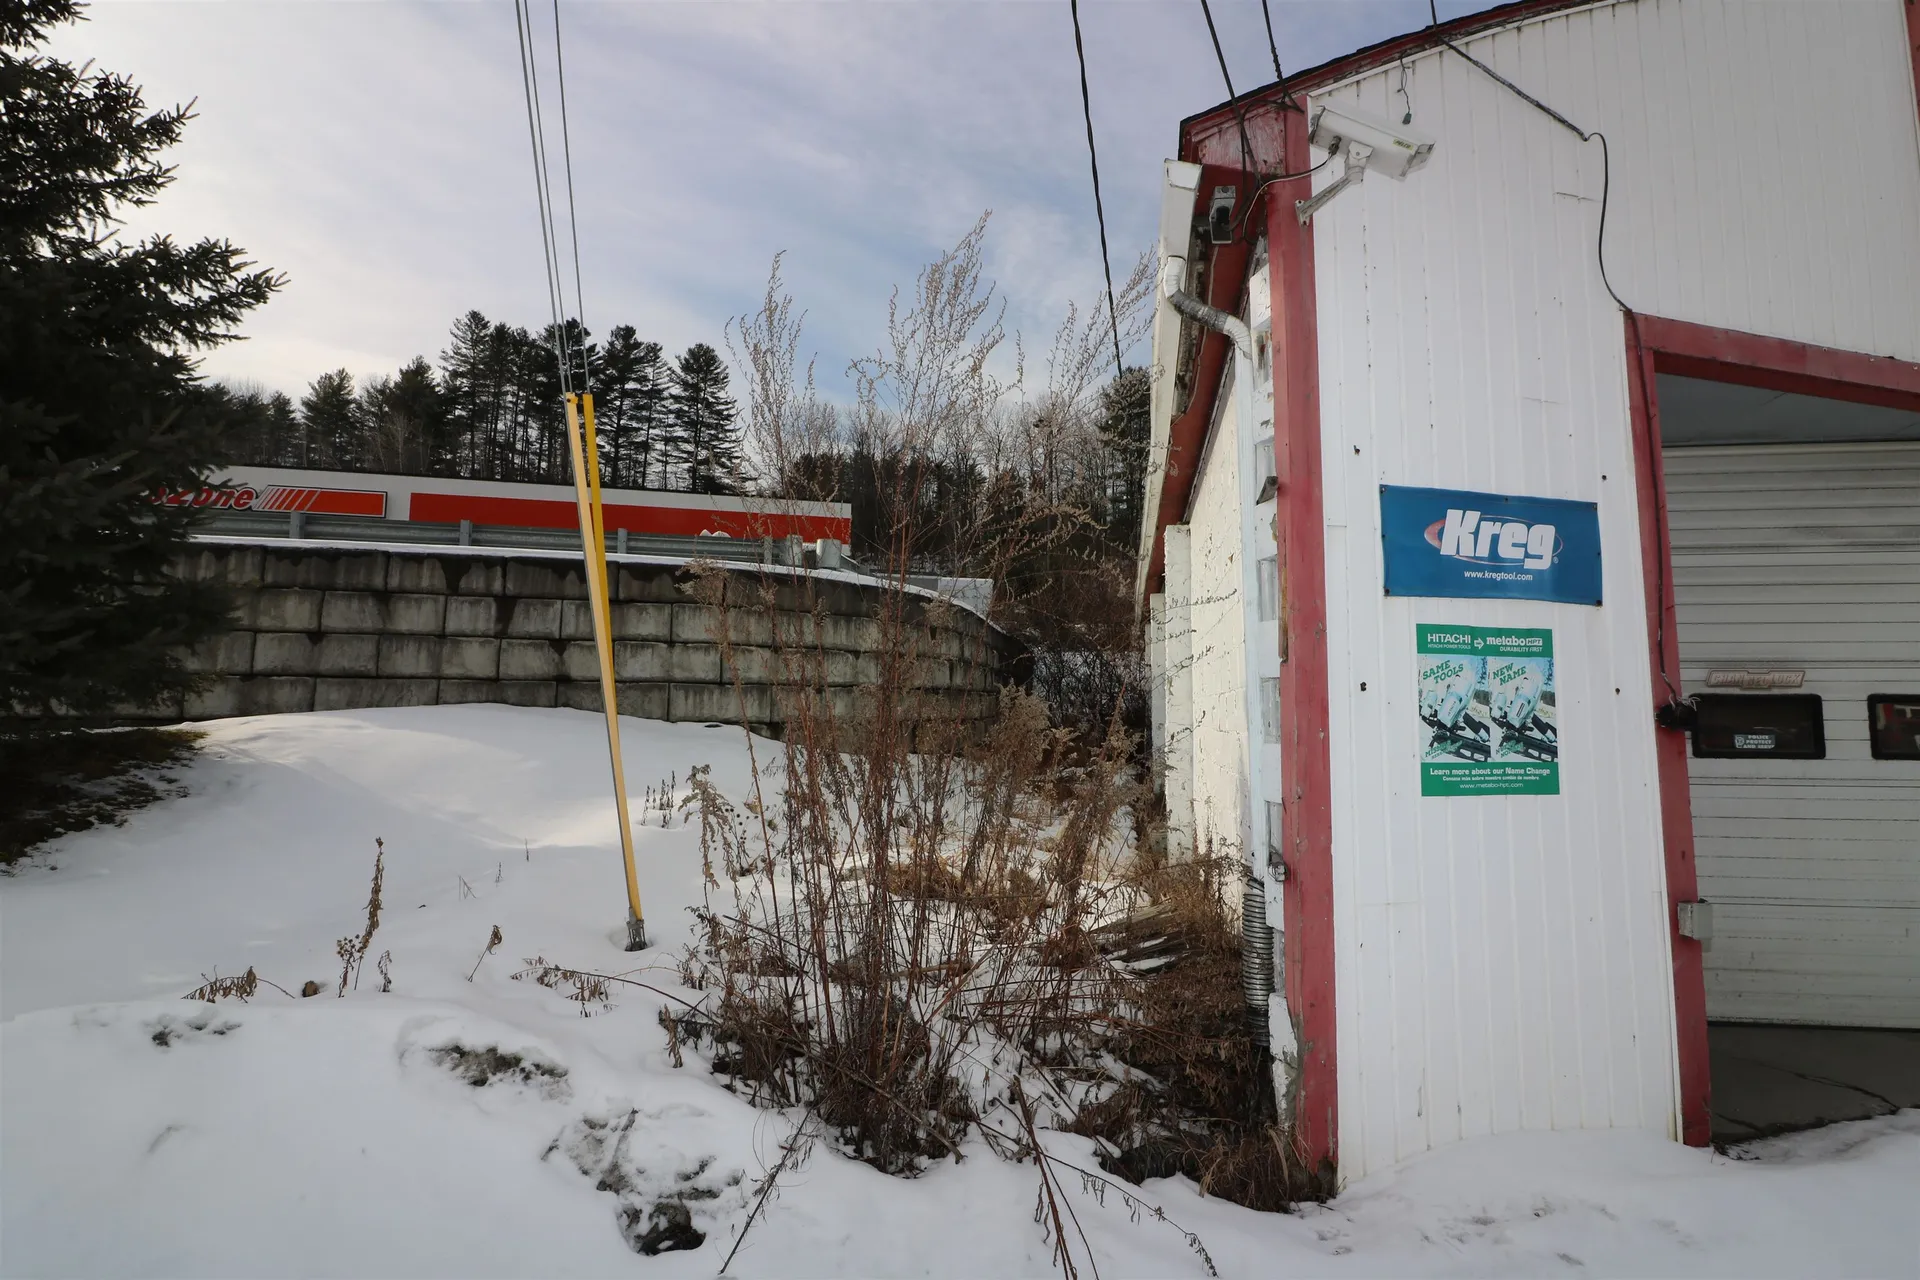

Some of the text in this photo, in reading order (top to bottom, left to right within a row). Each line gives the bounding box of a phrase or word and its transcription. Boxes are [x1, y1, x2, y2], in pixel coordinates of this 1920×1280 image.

[1440, 509, 1556, 570] Kreg
[1464, 570, 1533, 581] www.kregtool.com
[1427, 633, 1471, 643] HITACHI
[1486, 636, 1526, 646] metabo
[1422, 660, 1451, 680] SAME
[1433, 663, 1464, 684] TOOLS
[1492, 662, 1514, 680] NEW
[1499, 666, 1527, 686] NAME
[1526, 767, 1550, 776] Change
